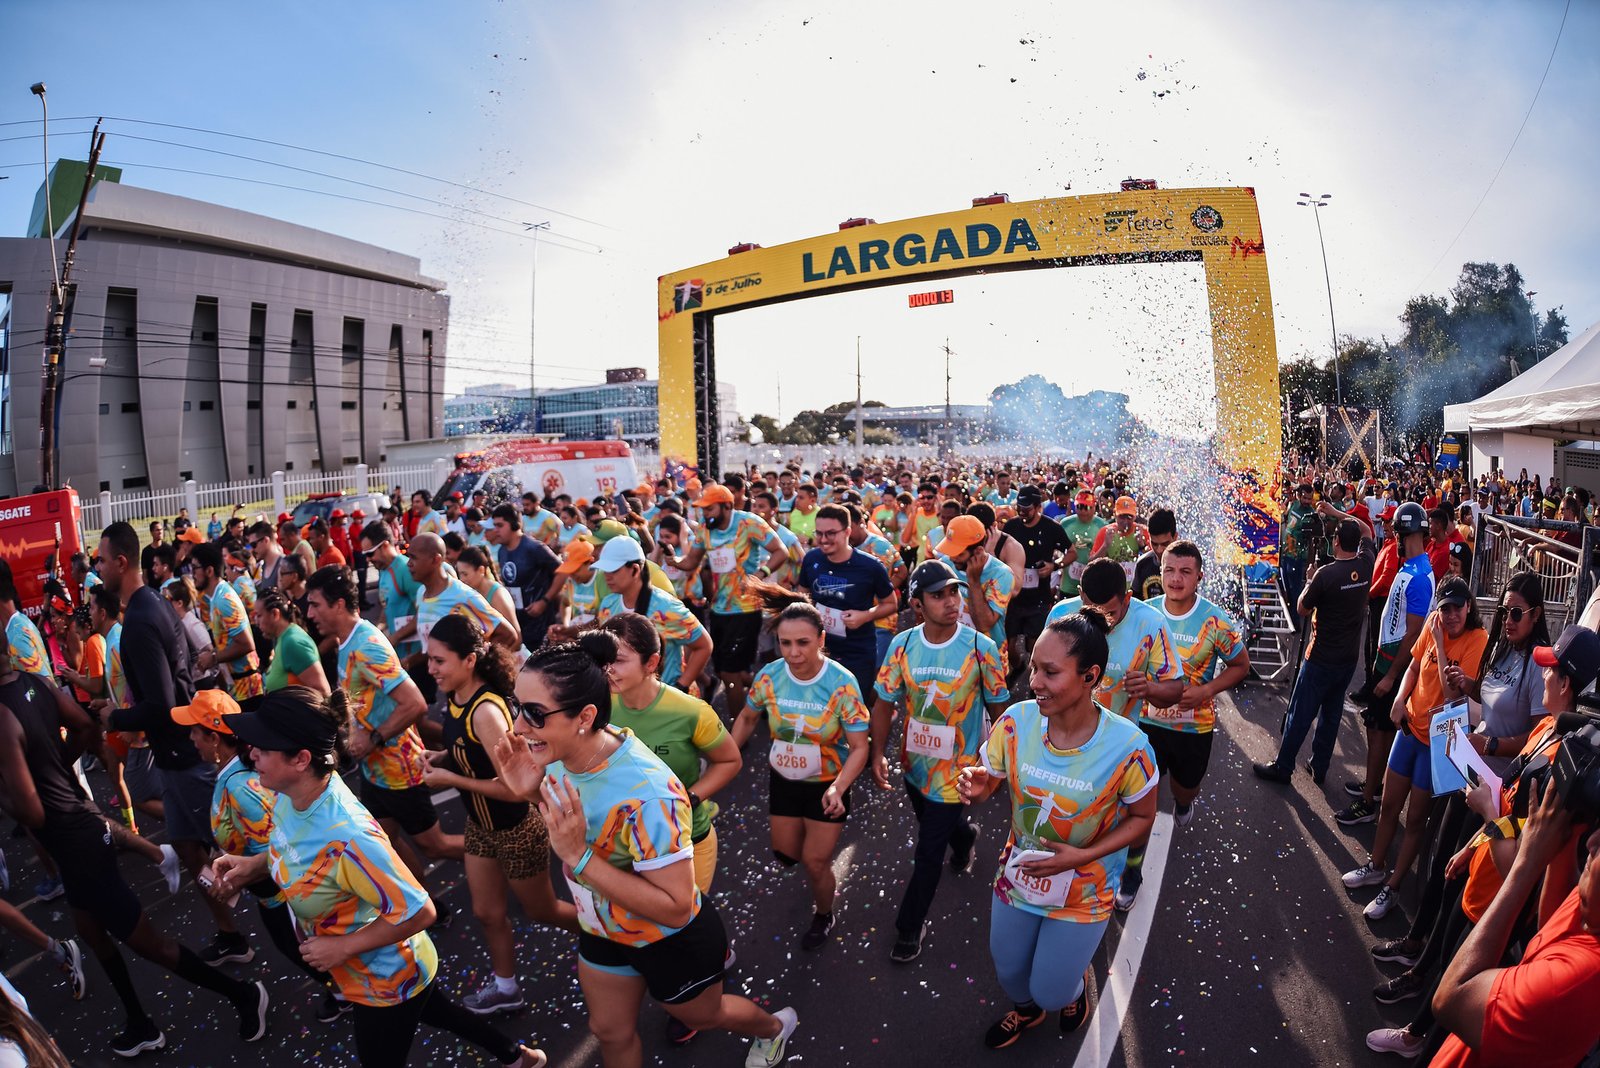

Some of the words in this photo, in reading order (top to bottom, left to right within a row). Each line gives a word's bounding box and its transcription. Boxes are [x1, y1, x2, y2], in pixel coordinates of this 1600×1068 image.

[802, 217, 1041, 283] LARGADA
[705, 286, 713, 297] 9
[715, 284, 729, 295] de
[730, 277, 762, 291] Julho
[594, 465, 616, 473] SAMU
[596, 477, 616, 492] 192
[1389, 579, 1406, 636] RORAIMA
[911, 666, 962, 678] PREFEITURA
[1154, 708, 1183, 719] 2425
[913, 731, 942, 748] 3070
[776, 753, 807, 769] 3268
[1020, 762, 1094, 792] PREFEITURA
[1014, 866, 1052, 893] 1430
